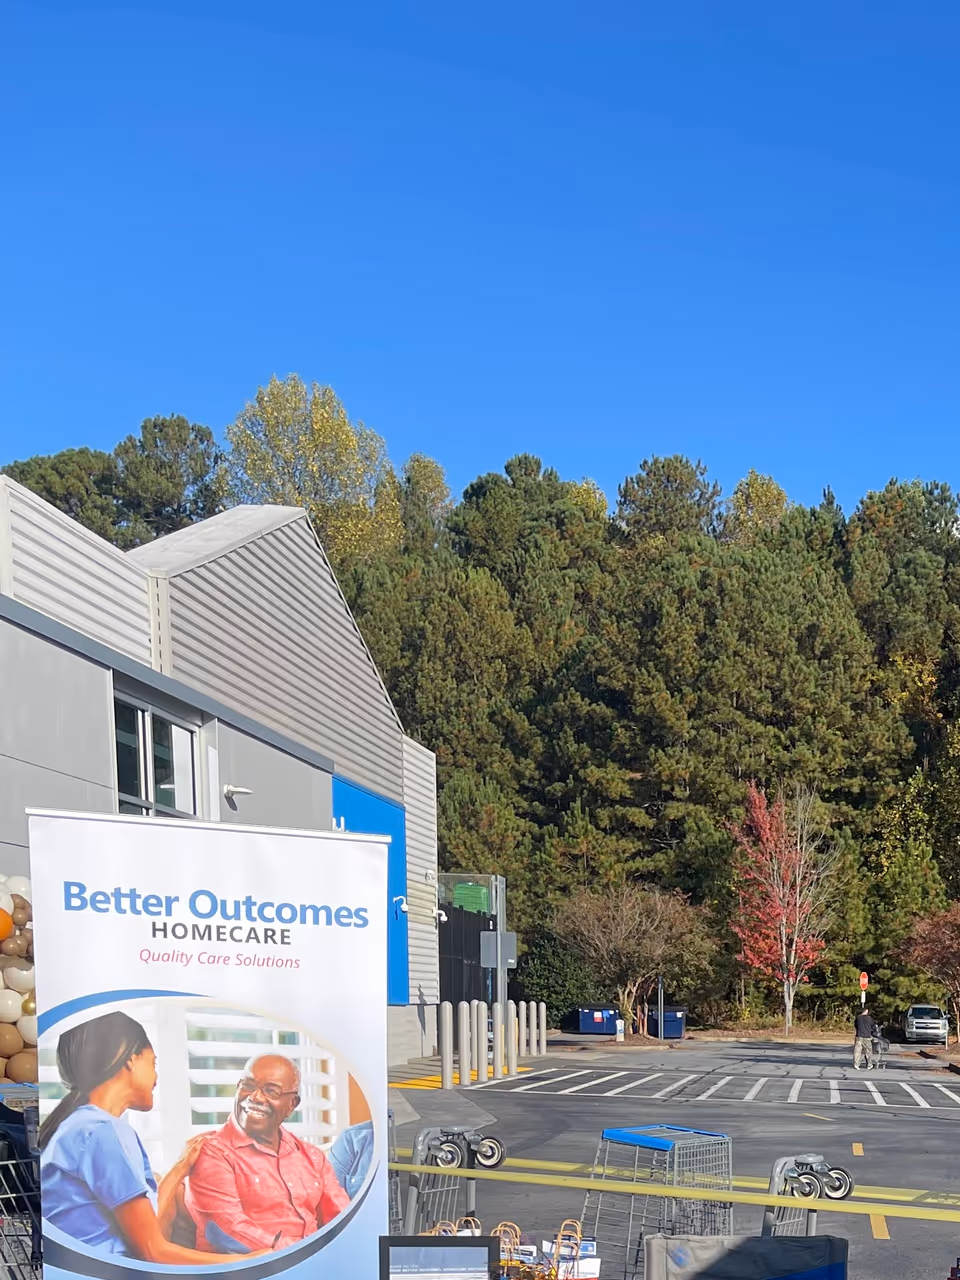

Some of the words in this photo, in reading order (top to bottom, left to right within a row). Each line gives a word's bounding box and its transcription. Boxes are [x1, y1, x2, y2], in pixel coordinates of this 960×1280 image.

[63, 881, 179, 917] Better
[189, 889, 369, 928] Outcomes
[152, 921, 291, 945] HOMECARE
[139, 948, 193, 967] Quality
[197, 951, 230, 965] Care
[235, 953, 301, 968] Solutions
